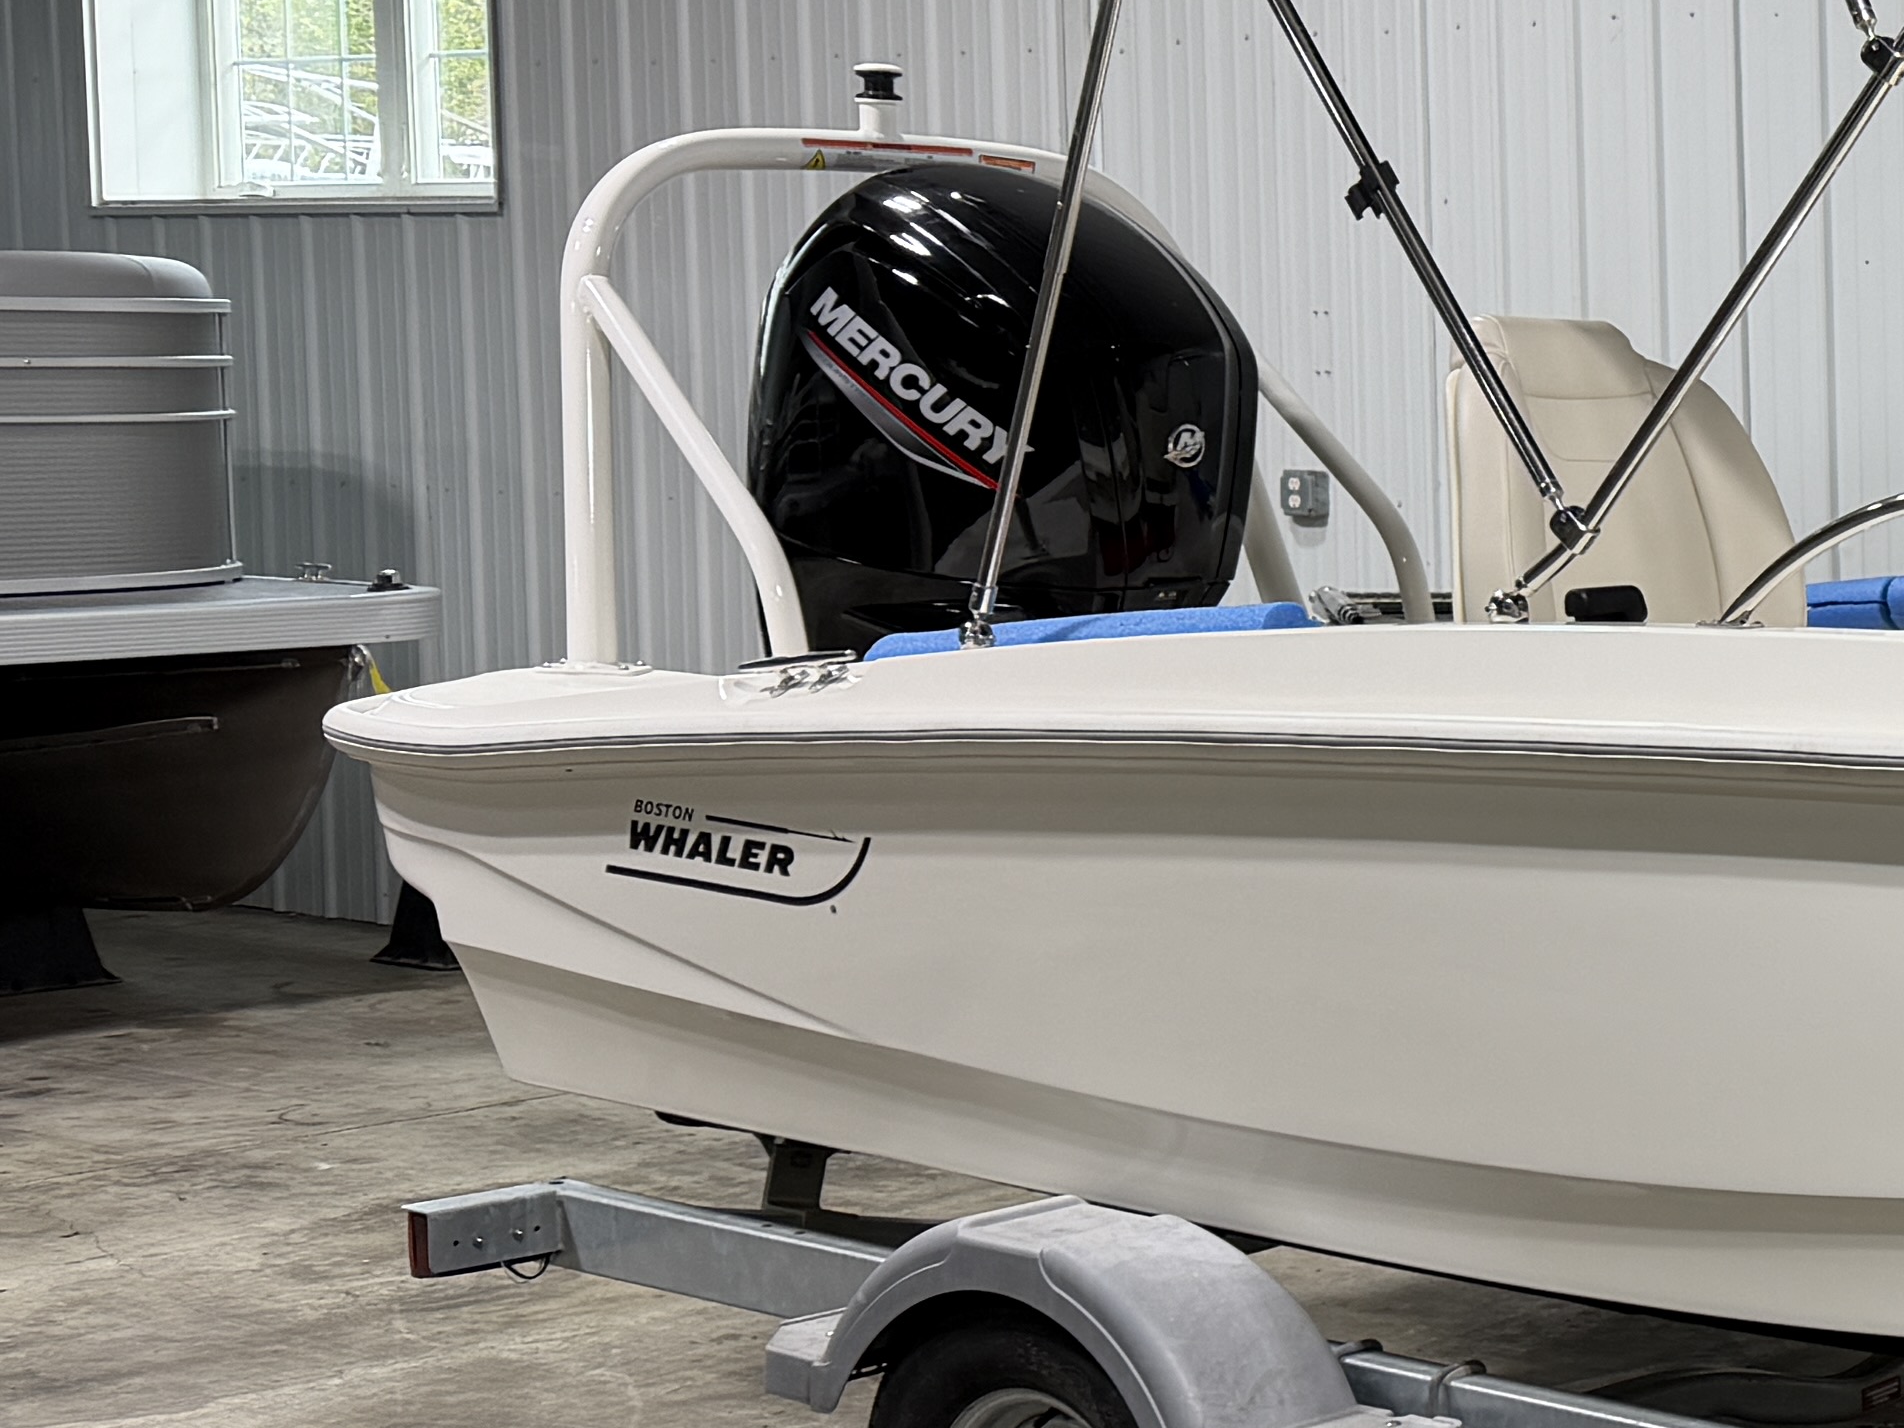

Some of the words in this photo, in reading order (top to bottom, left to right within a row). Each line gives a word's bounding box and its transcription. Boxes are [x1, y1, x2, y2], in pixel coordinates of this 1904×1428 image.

[810, 285, 1036, 465] MERCURY
[633, 798, 695, 823] BOSTON
[629, 819, 796, 878] WHALER
